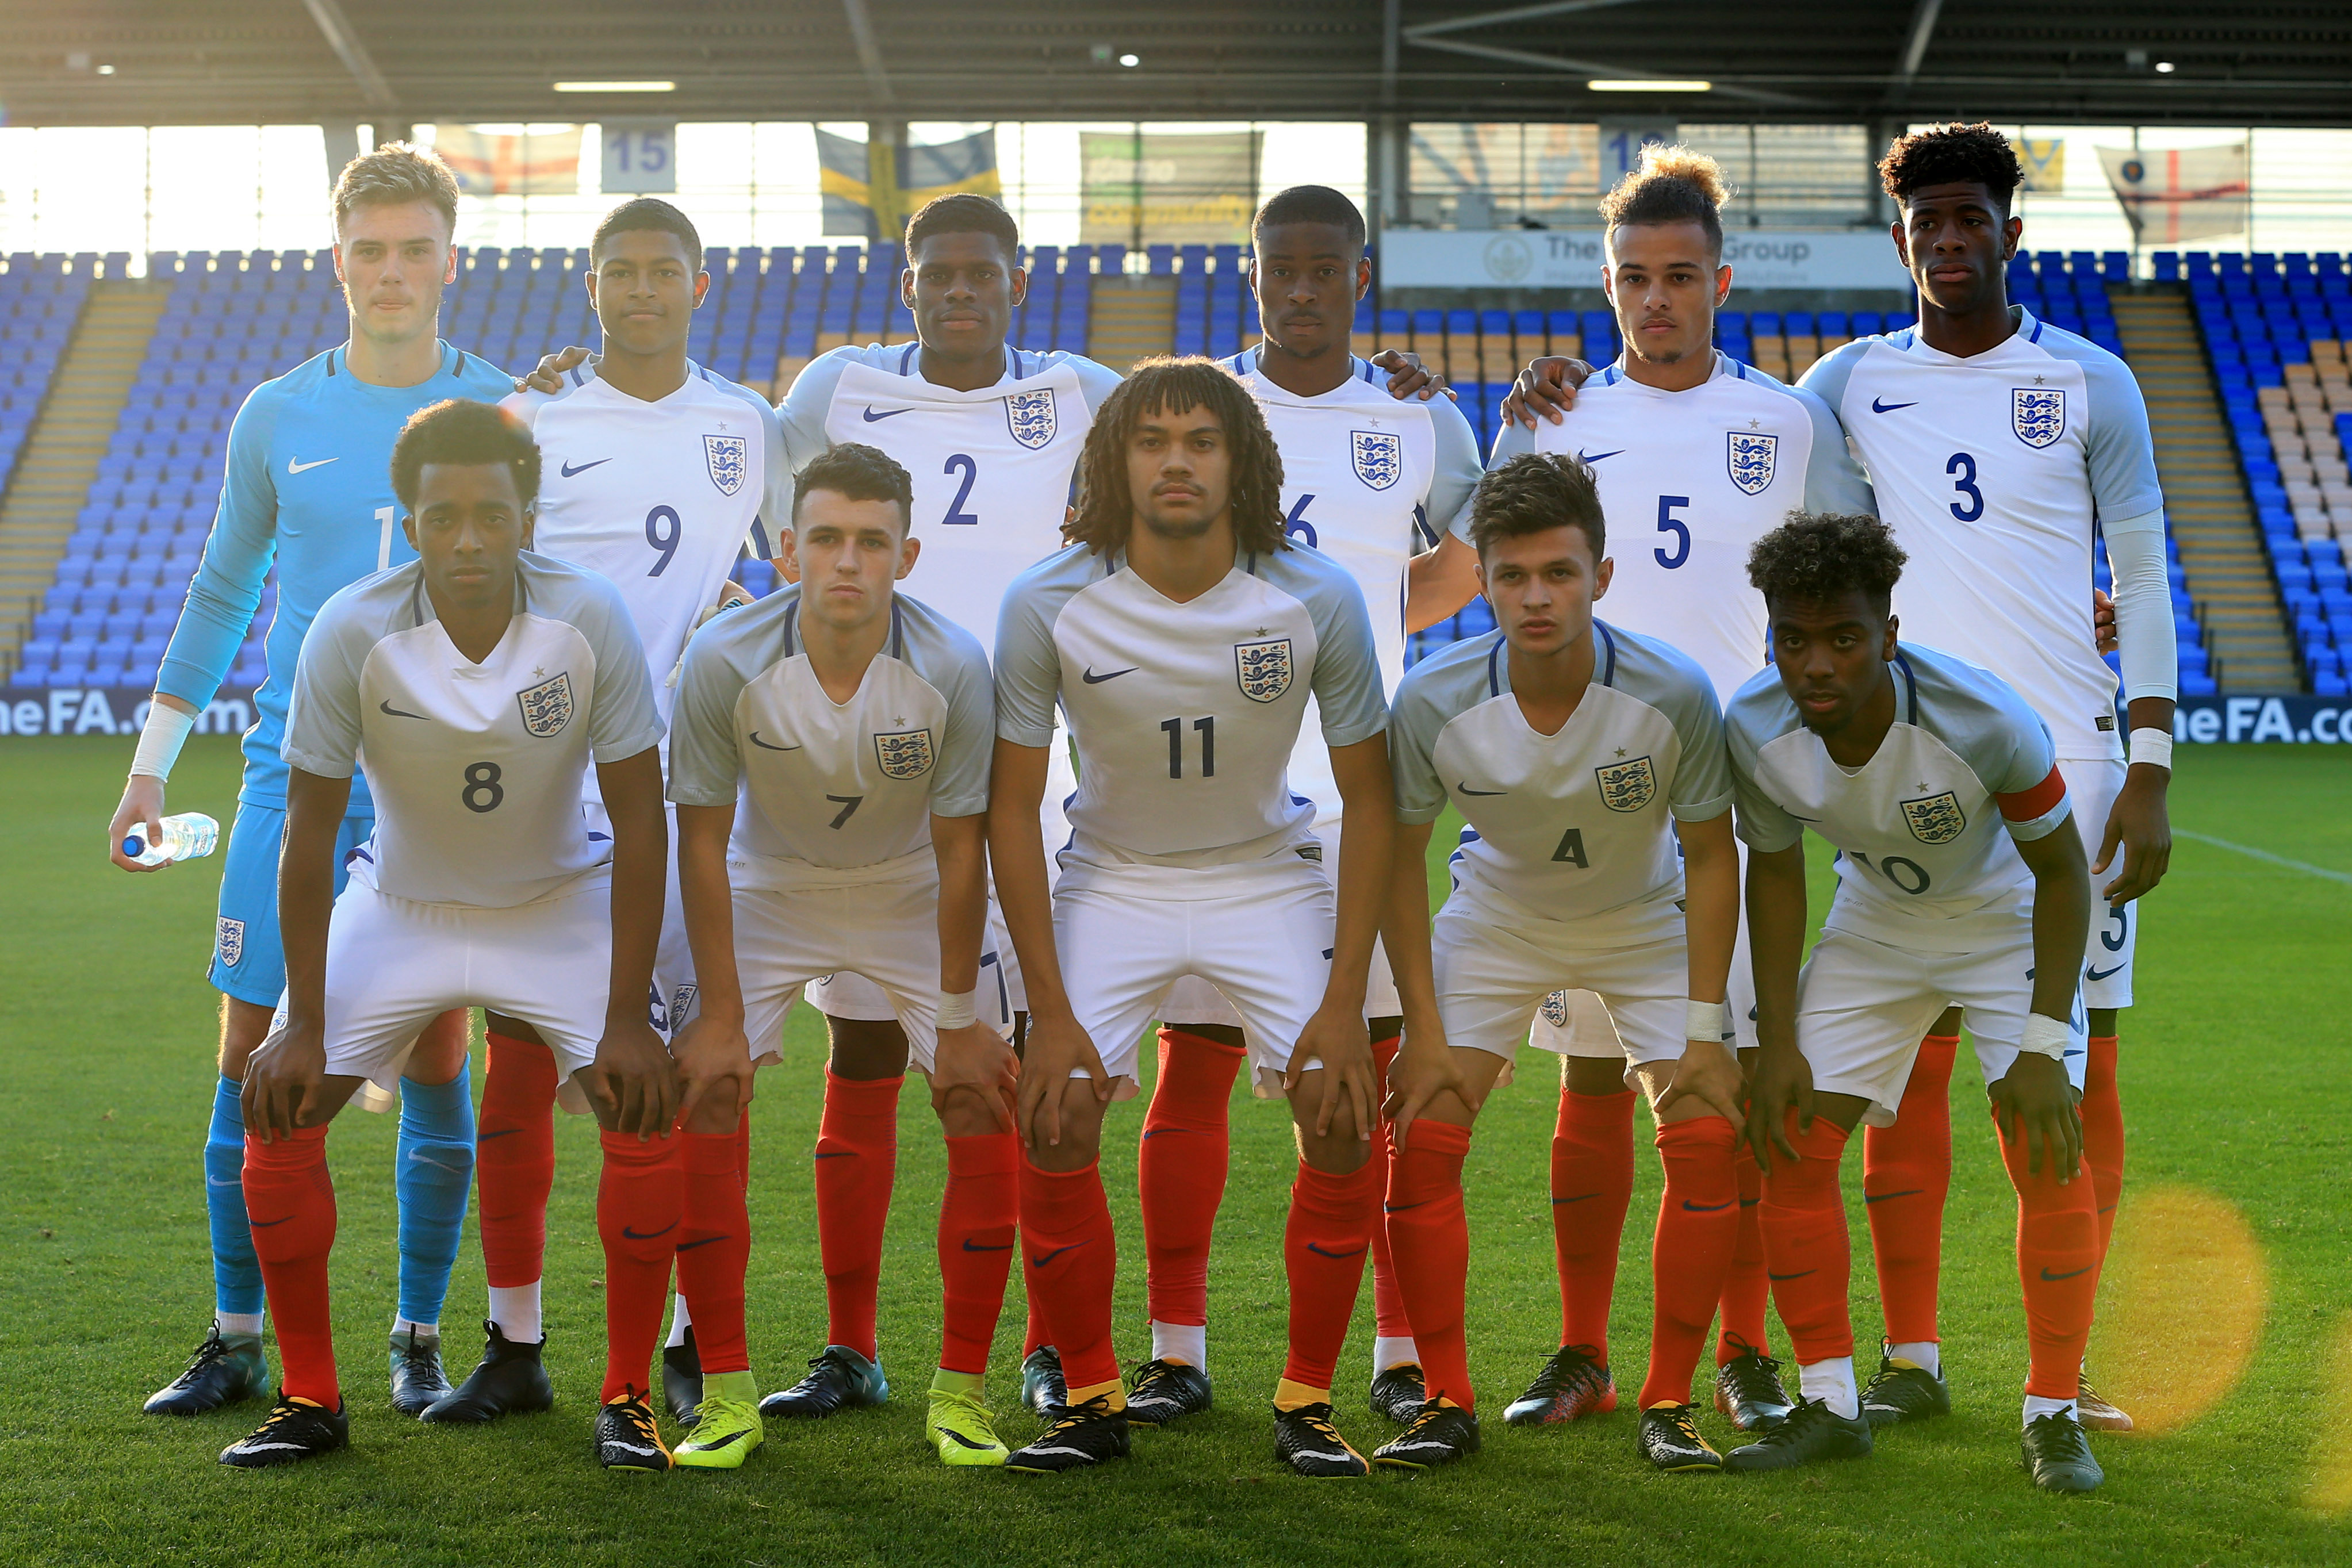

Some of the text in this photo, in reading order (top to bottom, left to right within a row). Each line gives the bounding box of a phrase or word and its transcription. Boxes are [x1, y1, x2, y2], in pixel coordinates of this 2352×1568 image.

[609, 129, 667, 172] 15
[1546, 235, 1811, 267] The Group
[941, 454, 978, 525] 2
[1946, 452, 1985, 523] 3
[374, 505, 394, 571] 1
[645, 505, 681, 577] 9
[1284, 493, 1317, 549] 6
[1654, 495, 1691, 570] 5
[1160, 716, 1215, 779] 11
[462, 761, 504, 813] 8
[826, 793, 864, 830] 7
[727, 860, 746, 868] I-FIT
[1550, 828, 1589, 869] 4
[1849, 851, 1930, 895] 10
[2101, 880, 2127, 952] 3
